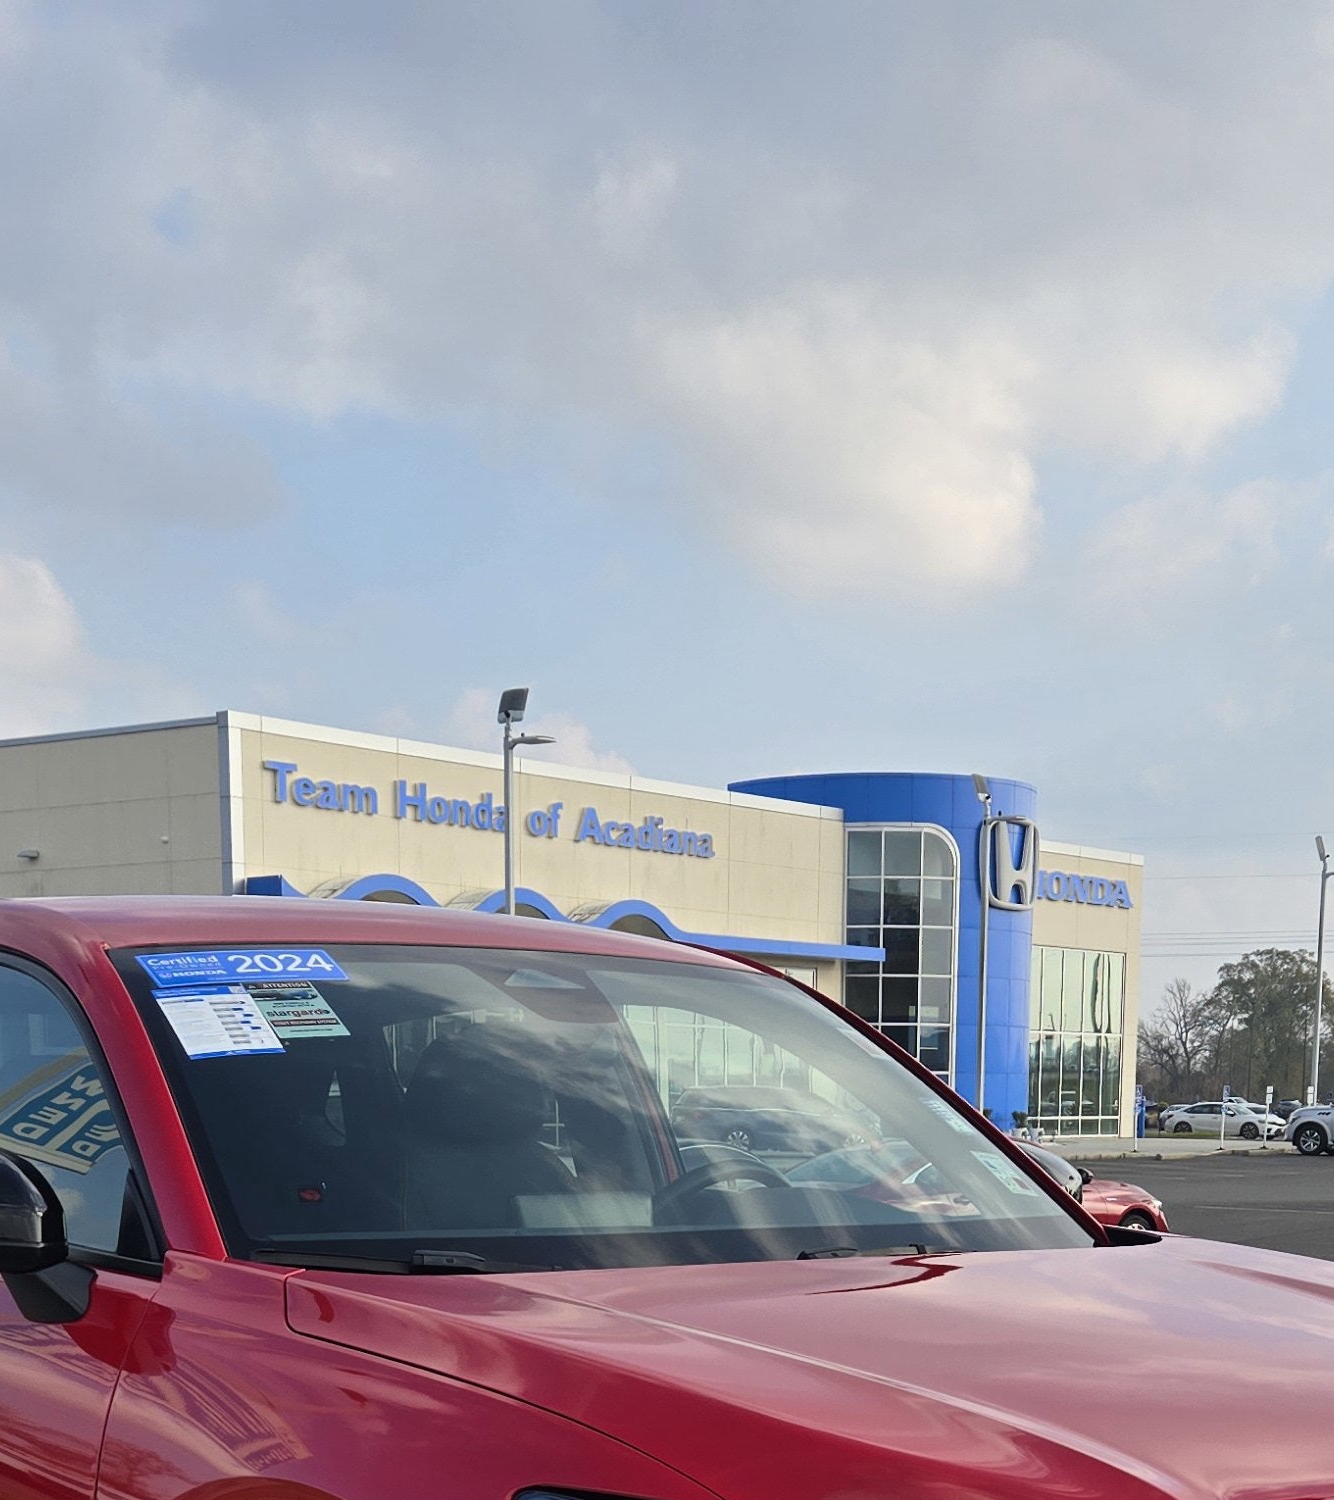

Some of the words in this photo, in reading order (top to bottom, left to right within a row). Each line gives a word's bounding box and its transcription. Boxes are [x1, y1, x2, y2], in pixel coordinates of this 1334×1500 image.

[262, 760, 378, 815] Team
[394, 779, 504, 832] Honda
[526, 801, 563, 839] of
[574, 806, 715, 858] Acadiana
[147, 955, 219, 966] Certified
[227, 953, 335, 974] 2024
